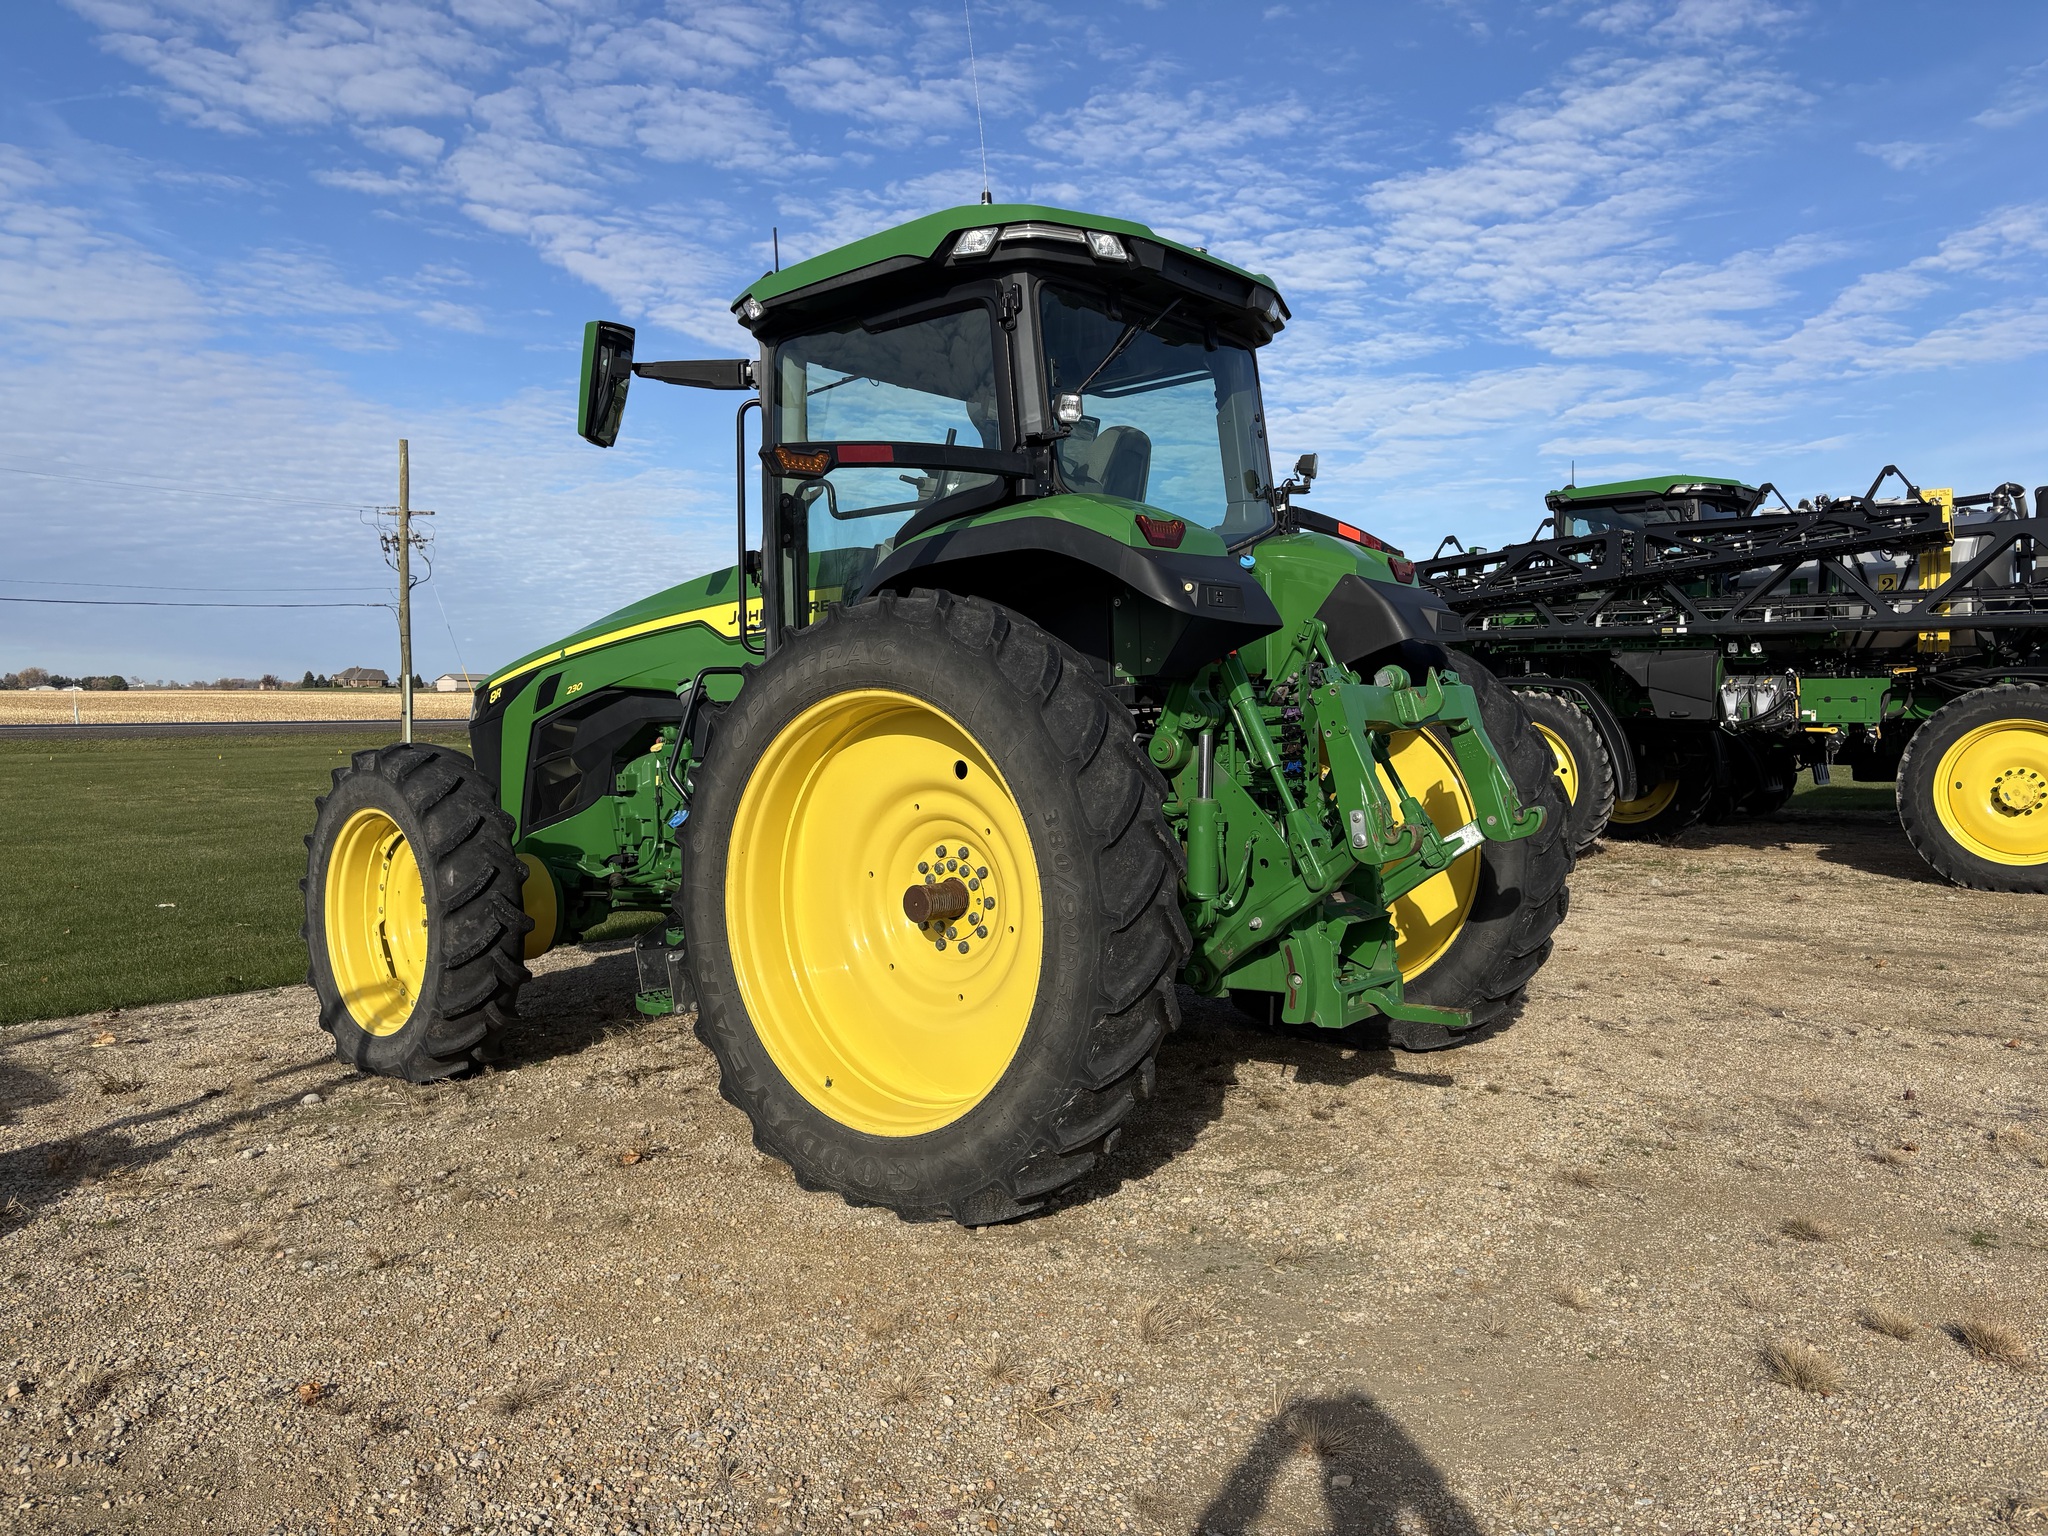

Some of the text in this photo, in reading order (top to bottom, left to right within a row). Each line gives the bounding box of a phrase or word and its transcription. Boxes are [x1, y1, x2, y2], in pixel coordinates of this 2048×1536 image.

[489, 687, 502, 704] 8R
[566, 681, 584, 695] 230
[1042, 808, 1080, 1023] 380/90R54
